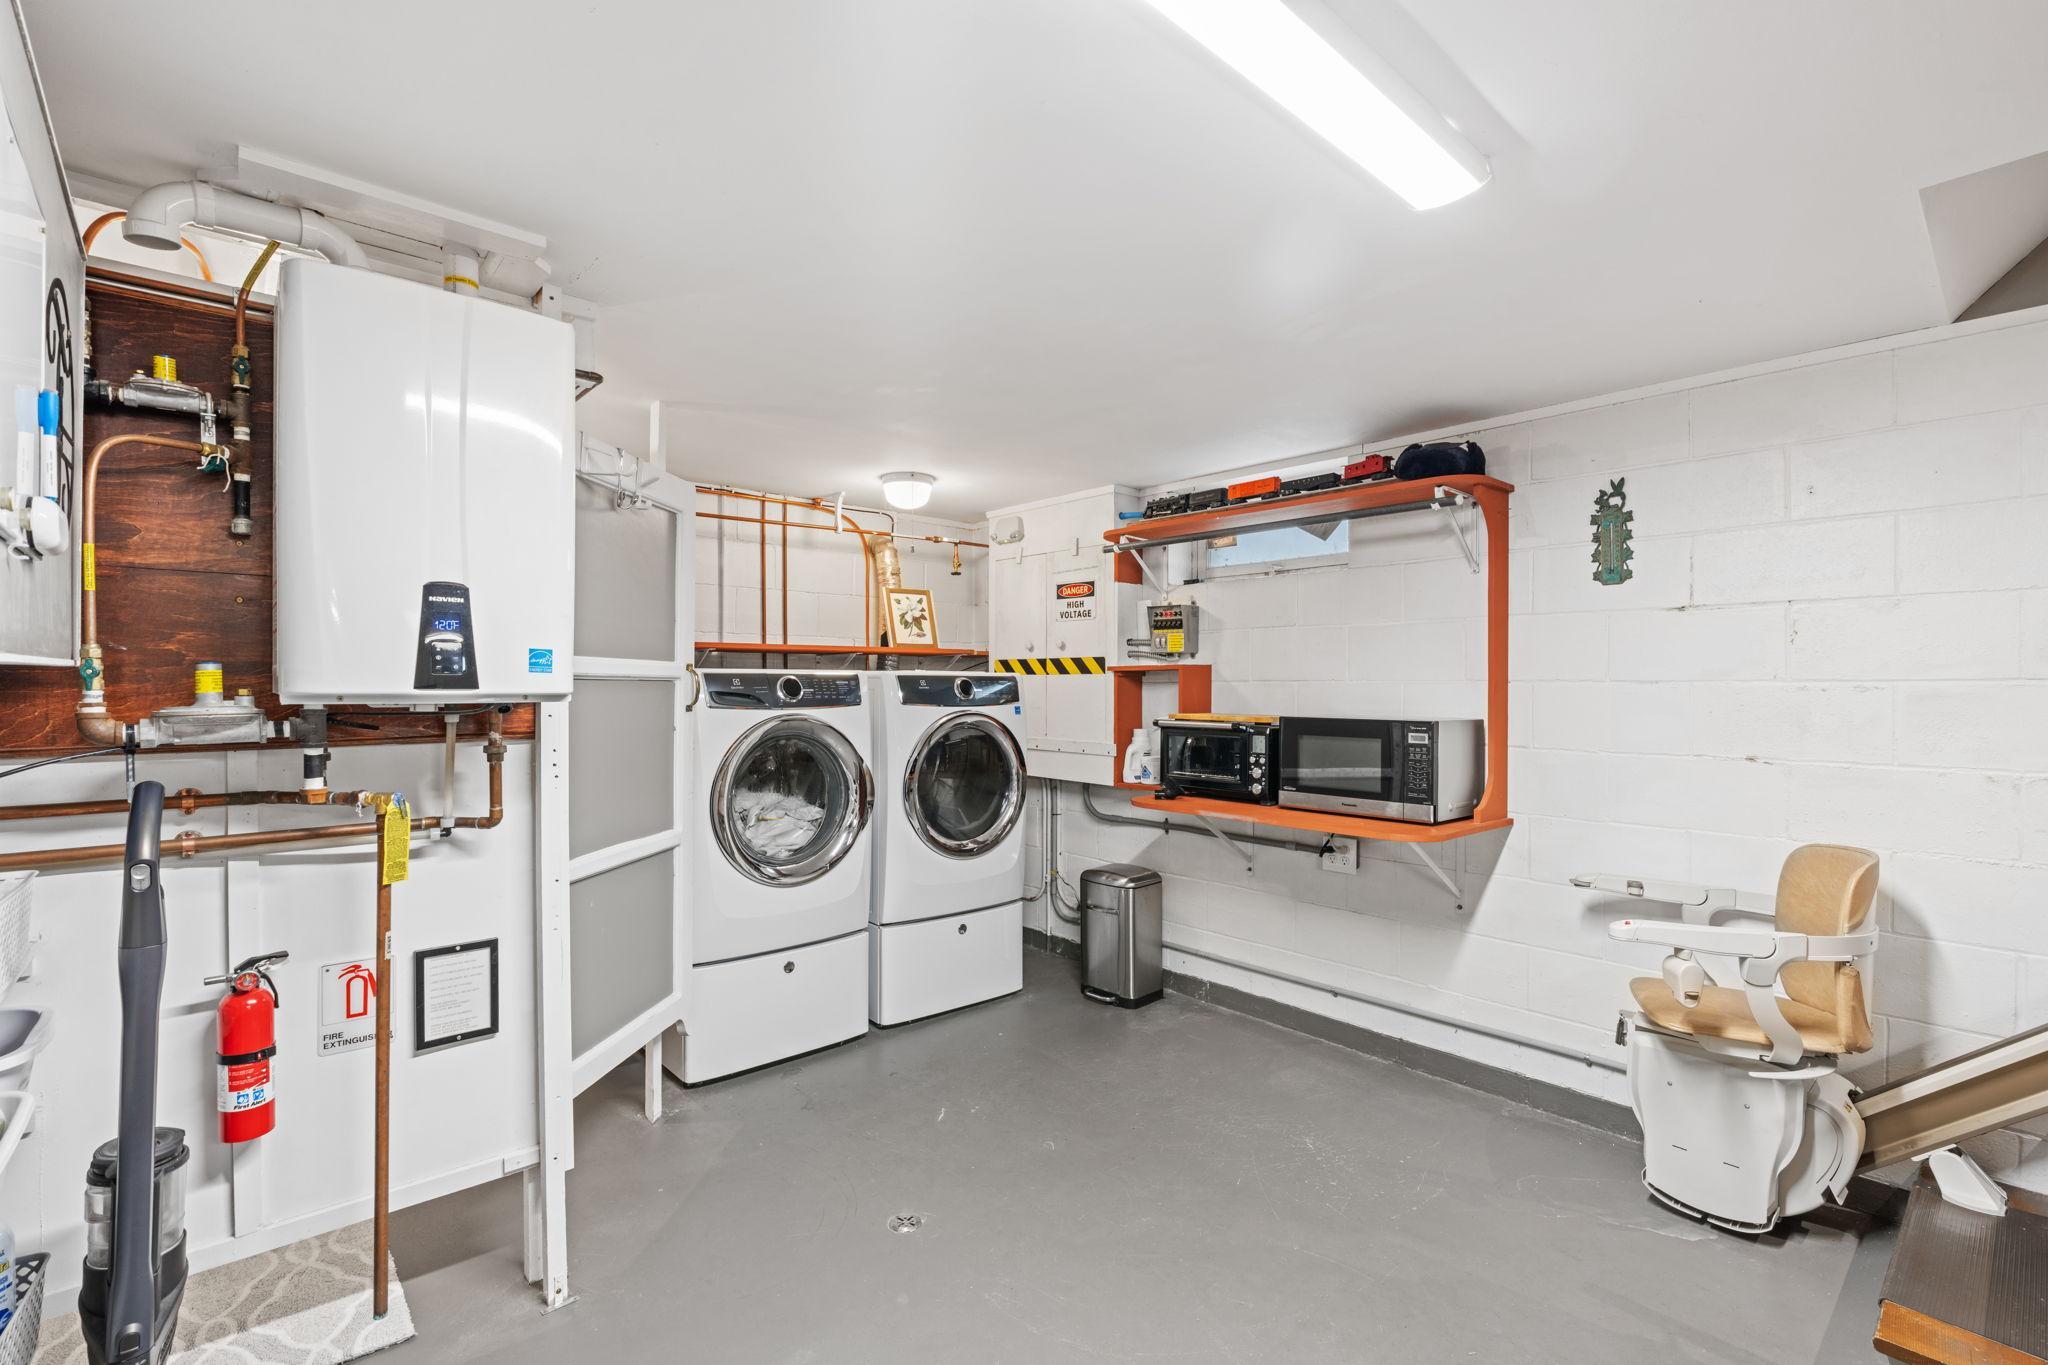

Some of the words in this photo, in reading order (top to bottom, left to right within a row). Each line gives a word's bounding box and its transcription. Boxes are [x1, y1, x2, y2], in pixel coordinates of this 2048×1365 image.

[1062, 586, 1089, 596] DANGER
[1066, 600, 1085, 609] HIGH
[1059, 609, 1092, 619] VOLTAGE
[323, 1031, 344, 1042] FIRE
[250, 1097, 266, 1107] Alert
